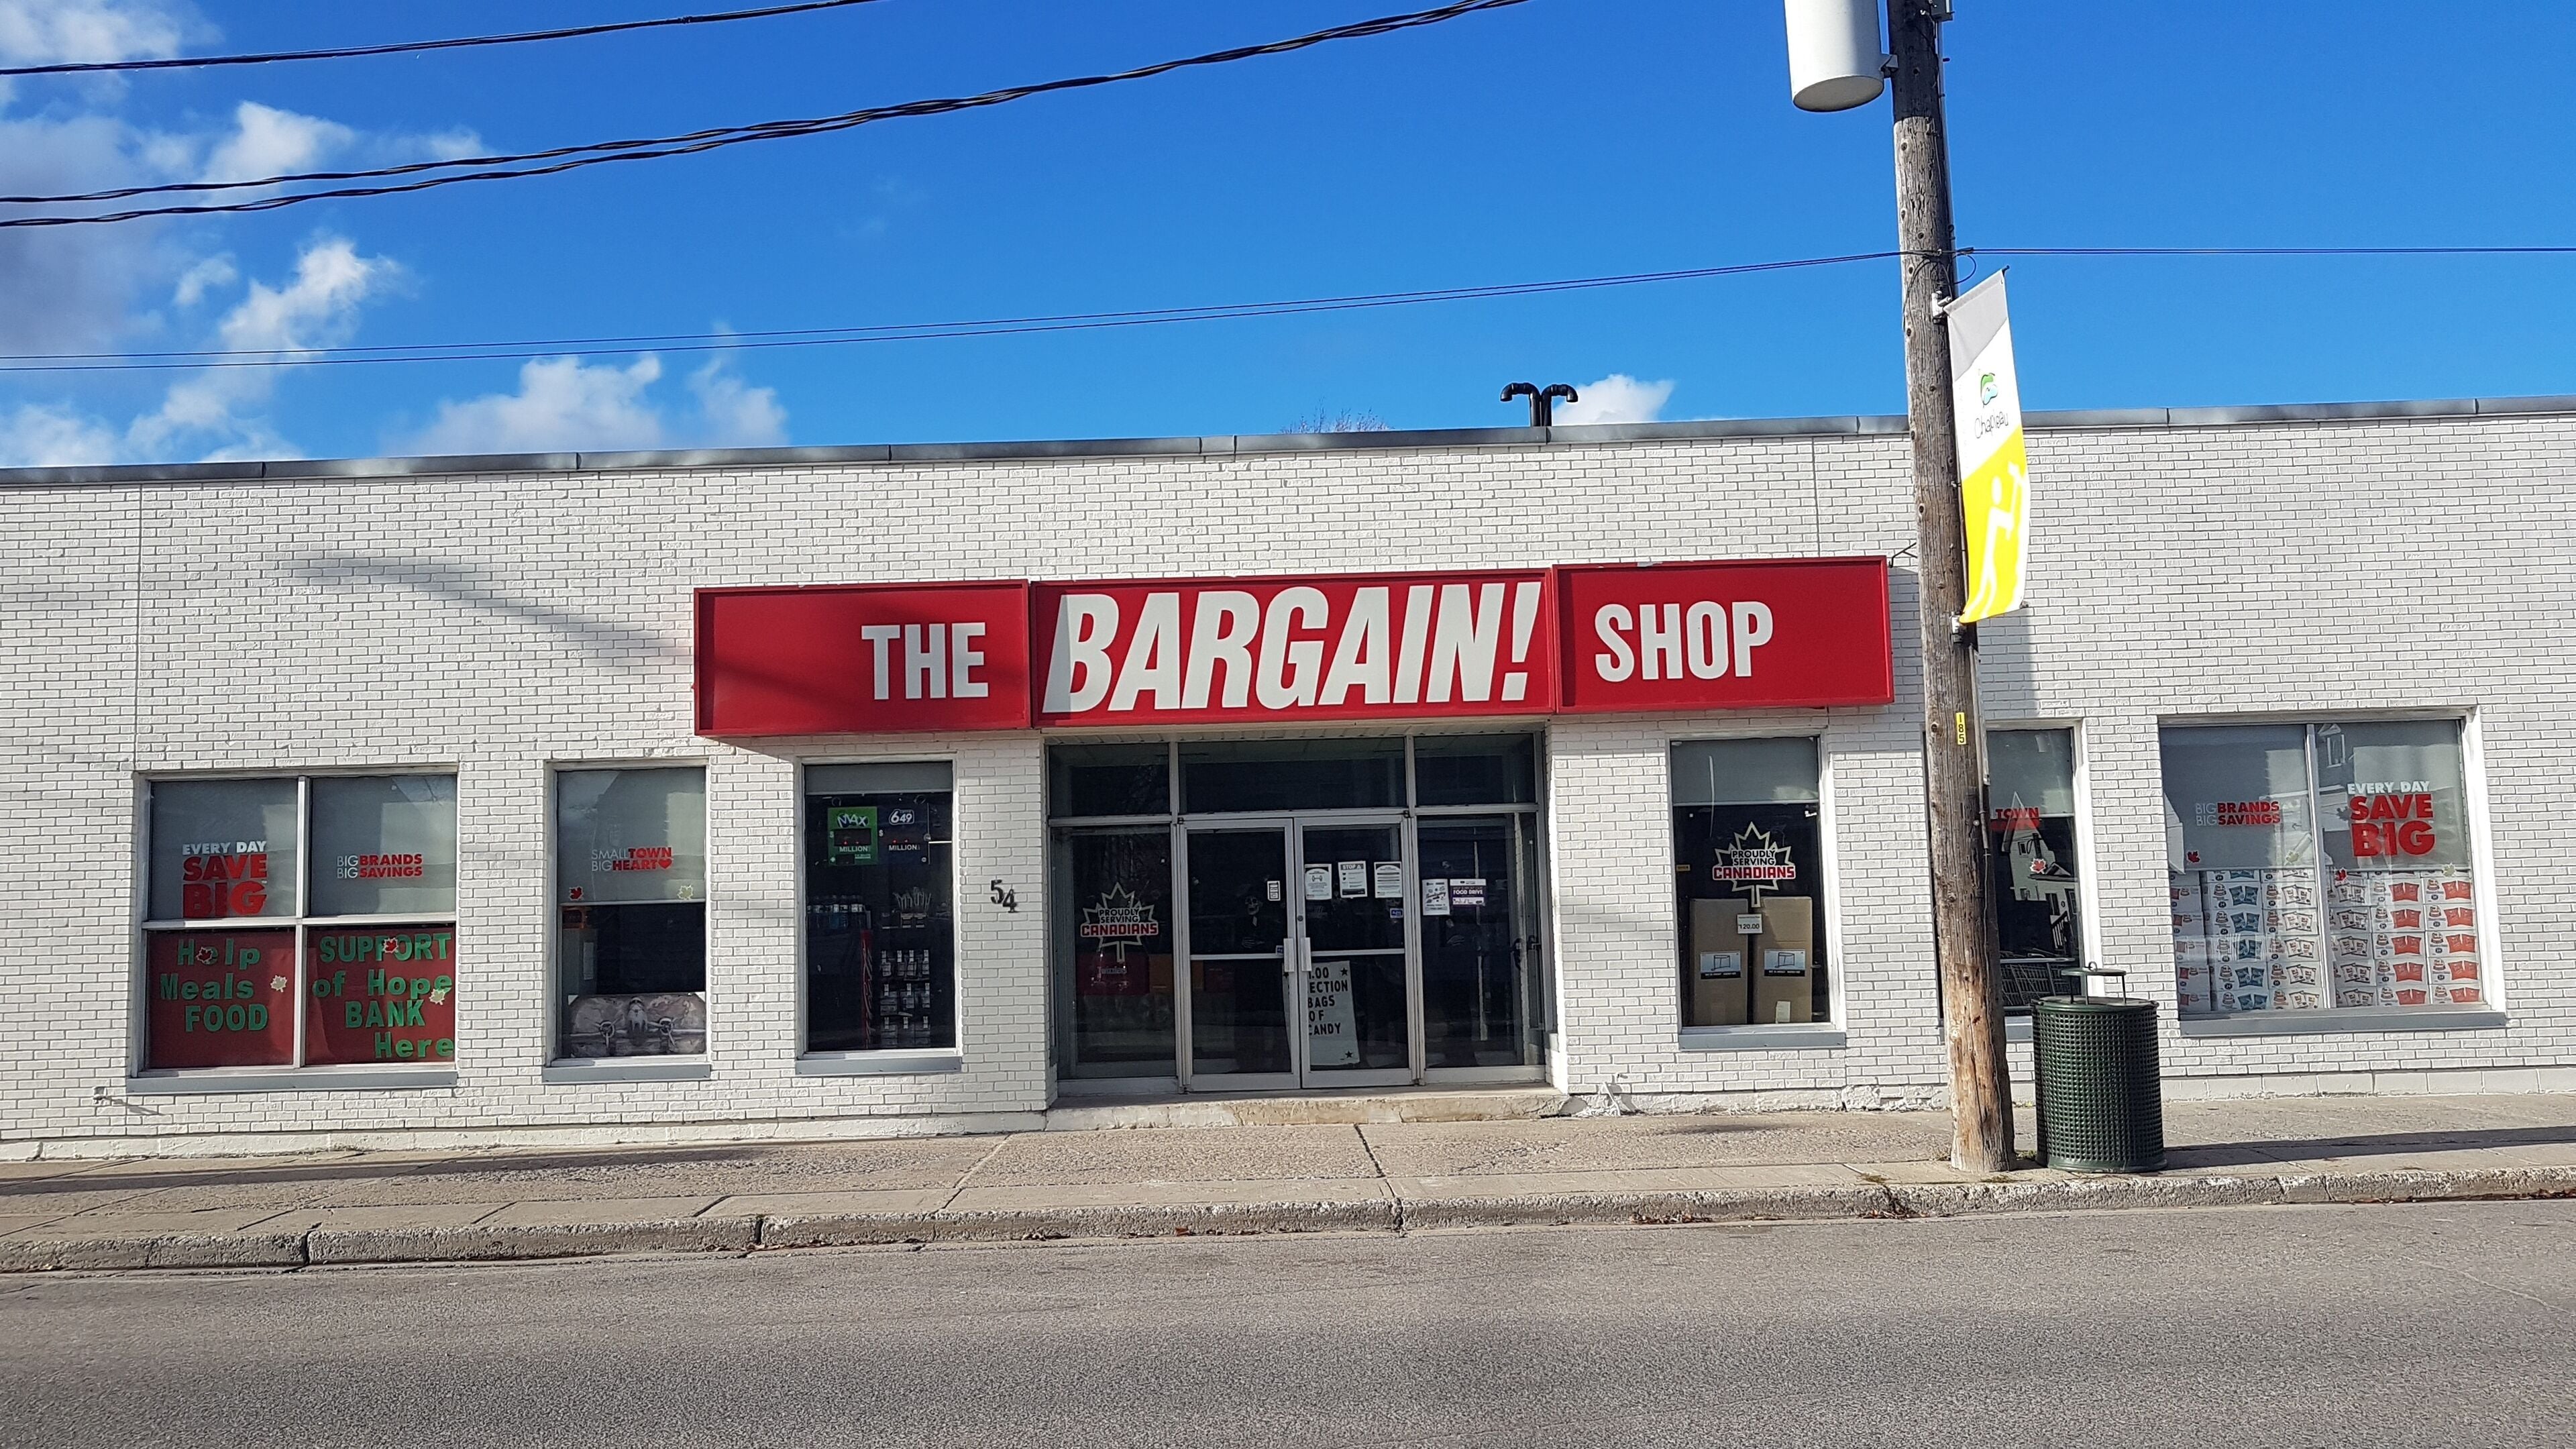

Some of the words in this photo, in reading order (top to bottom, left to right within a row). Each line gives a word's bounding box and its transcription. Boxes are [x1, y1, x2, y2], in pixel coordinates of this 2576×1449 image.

[861, 622, 989, 700] THE
[1042, 582, 1542, 714] BARGAIN!
[1595, 600, 1773, 682] SHOP
[2347, 782, 2394, 795] EVERY
[2400, 781, 2430, 793] DAY
[1995, 807, 2039, 820] TOWN
[2350, 794, 2434, 820] SAVE
[837, 814, 867, 828] MAX
[2351, 820, 2435, 856] BIG
[182, 842, 231, 855] EVERY
[236, 841, 267, 853] DAY
[1731, 849, 1776, 858] PROUDLY
[183, 854, 267, 881] SAVE
[1733, 857, 1775, 866] SERVING
[1713, 866, 1794, 879] CANADIANS
[183, 881, 267, 918] BIG
[990, 879, 1019, 913] 54
[1099, 908, 1139, 917] PROUDLY
[1100, 915, 1139, 924] SERVING
[1081, 923, 1158, 936] CANADIANS
[319, 932, 452, 963] SUPPORT
[160, 973, 254, 1000] Meals
[312, 970, 346, 998] of
[367, 968, 453, 1000] Hope
[1309, 980, 1348, 994] ECTION
[1308, 995, 1335, 1008] BAGS
[185, 1003, 268, 1032] FOOD
[345, 999, 425, 1028] BANK
[374, 1031, 454, 1059] Here
